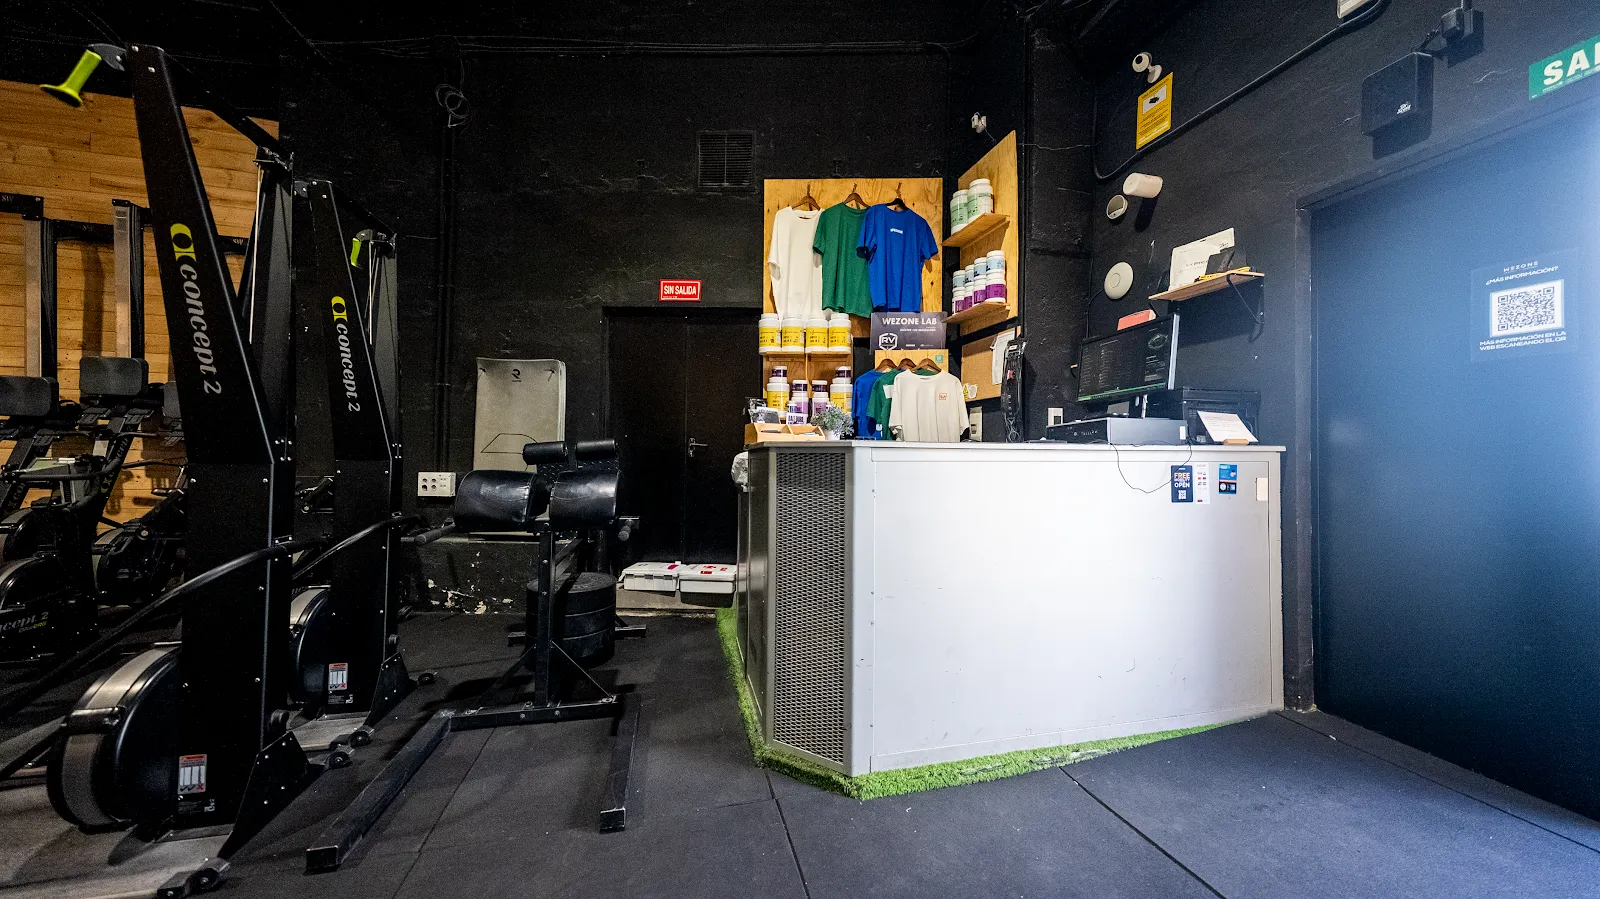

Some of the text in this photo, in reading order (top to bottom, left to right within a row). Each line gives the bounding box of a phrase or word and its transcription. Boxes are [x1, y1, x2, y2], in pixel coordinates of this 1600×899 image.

[1503, 261, 1539, 272] WEZONE
[1504, 265, 1559, 281] INFORMACIÓN?
[663, 285, 697, 295] SIN SALIDA
[882, 317, 937, 325] WEZONE LAB
[180, 263, 222, 394] concept 2
[1495, 333, 1544, 344] INFORMACIÓN
[1496, 339, 1545, 349] ESCANEANDO
[336, 323, 361, 412] concept 2
